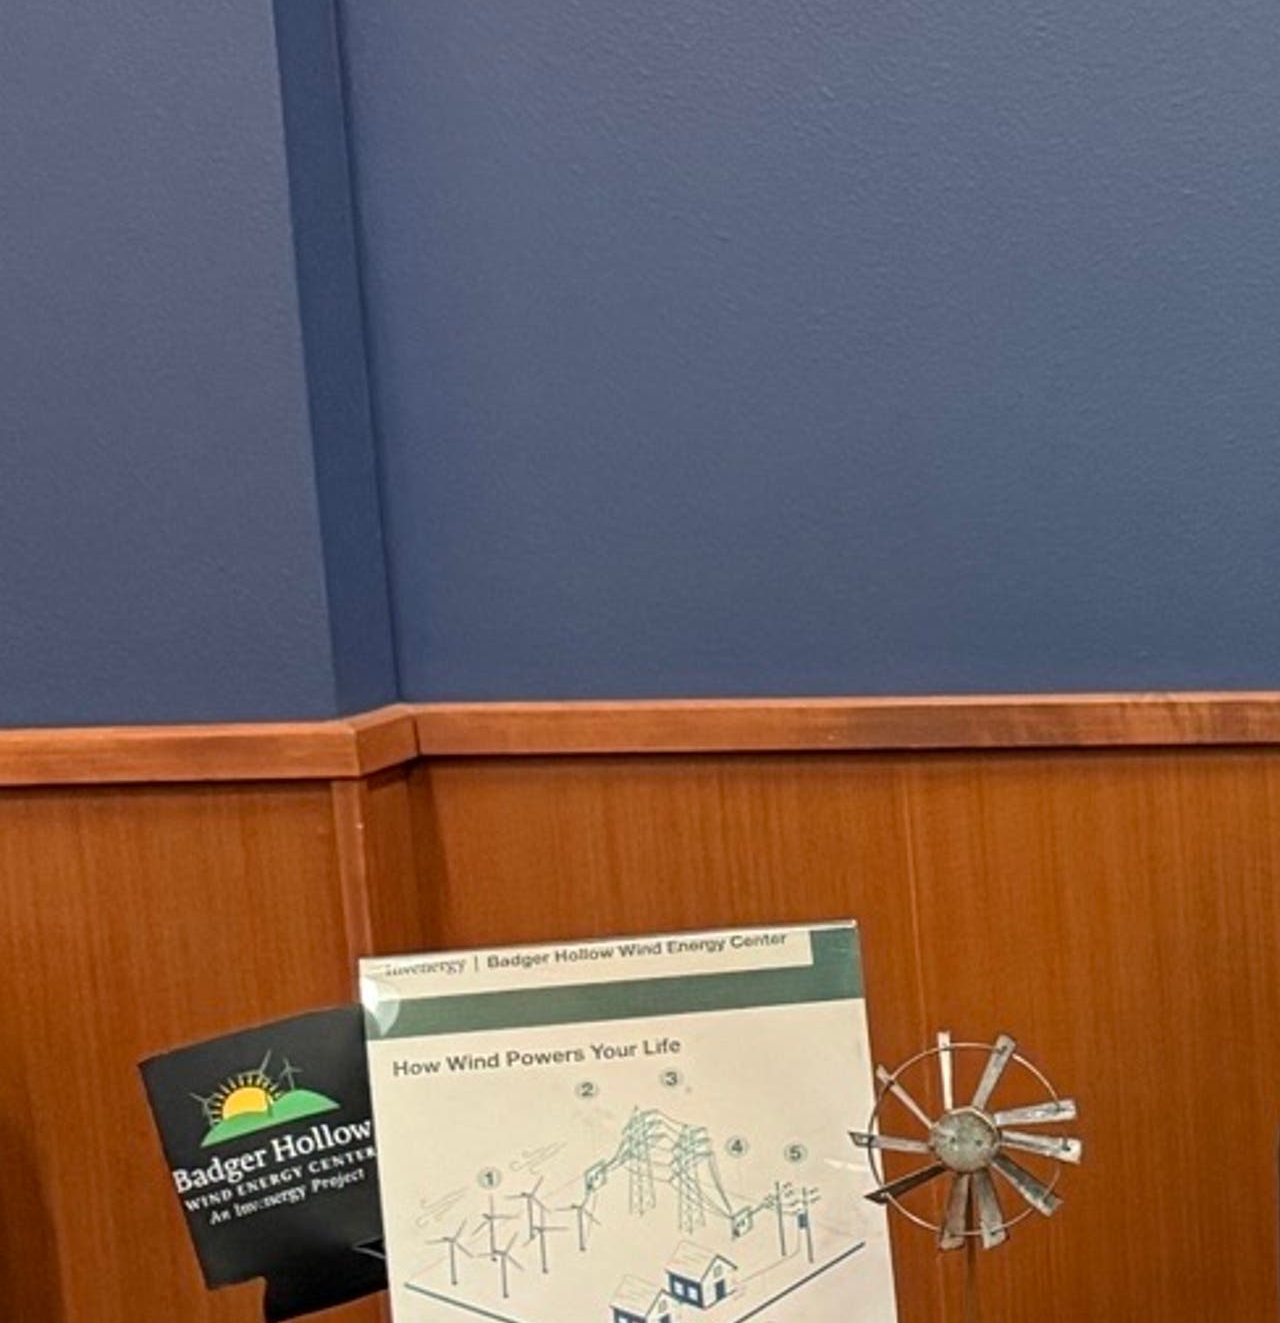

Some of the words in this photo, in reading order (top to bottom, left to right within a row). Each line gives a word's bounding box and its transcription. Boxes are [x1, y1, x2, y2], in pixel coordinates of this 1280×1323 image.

[487, 951, 549, 969] Badger
[555, 946, 614, 963] Hollow
[618, 942, 662, 958] Wind
[668, 936, 726, 954] Energy
[730, 933, 787, 949] Center
[392, 1059, 441, 1077] How
[446, 1053, 500, 1072] Wind
[506, 1045, 586, 1068] Powers
[590, 1042, 637, 1060] Your
[643, 1037, 681, 1056] Life
[171, 1148, 269, 1194] Badger
[270, 1120, 373, 1164] Hollow
[184, 1188, 233, 1213] WIND
[237, 1165, 304, 1196] ENERGY
[308, 1146, 376, 1174] CENTER
[209, 1208, 231, 1225] An
[312, 1167, 366, 1193] Project
